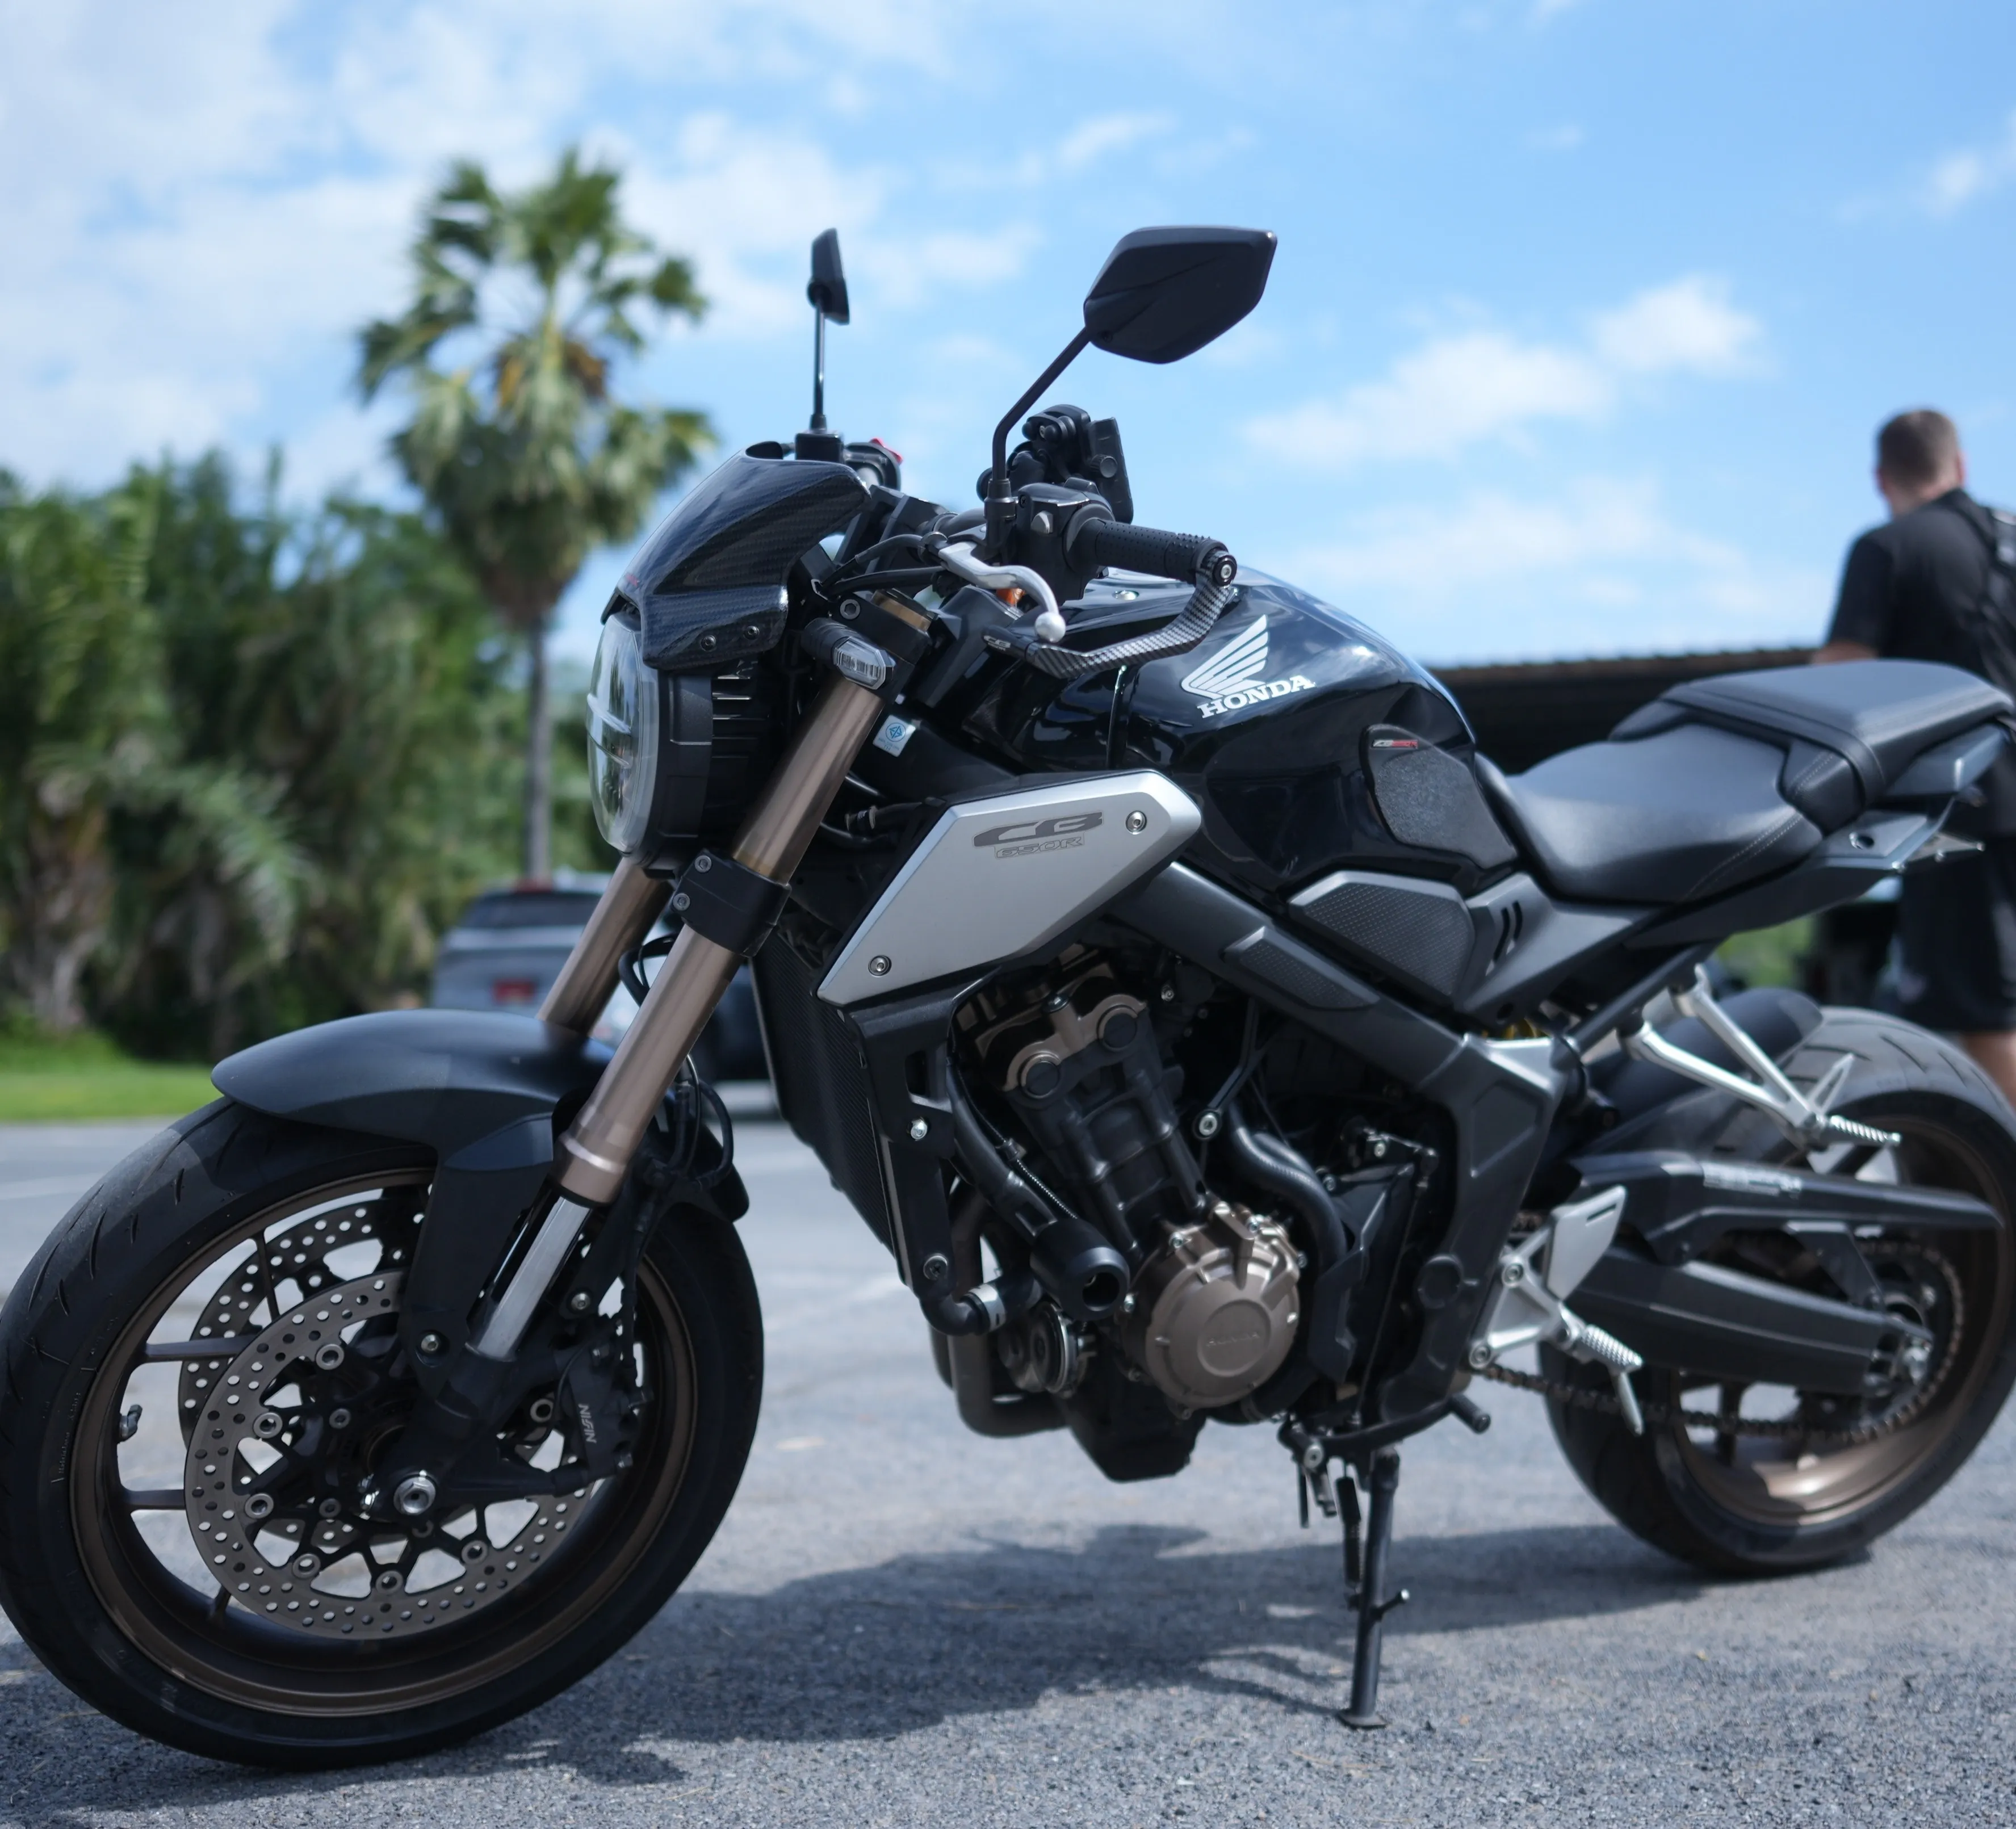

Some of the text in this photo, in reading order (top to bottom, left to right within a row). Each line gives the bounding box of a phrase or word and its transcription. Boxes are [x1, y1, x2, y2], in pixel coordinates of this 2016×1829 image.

[1196, 674, 1316, 719] HONDA
[973, 811, 1103, 847] CB
[996, 837, 1083, 858] 650R
